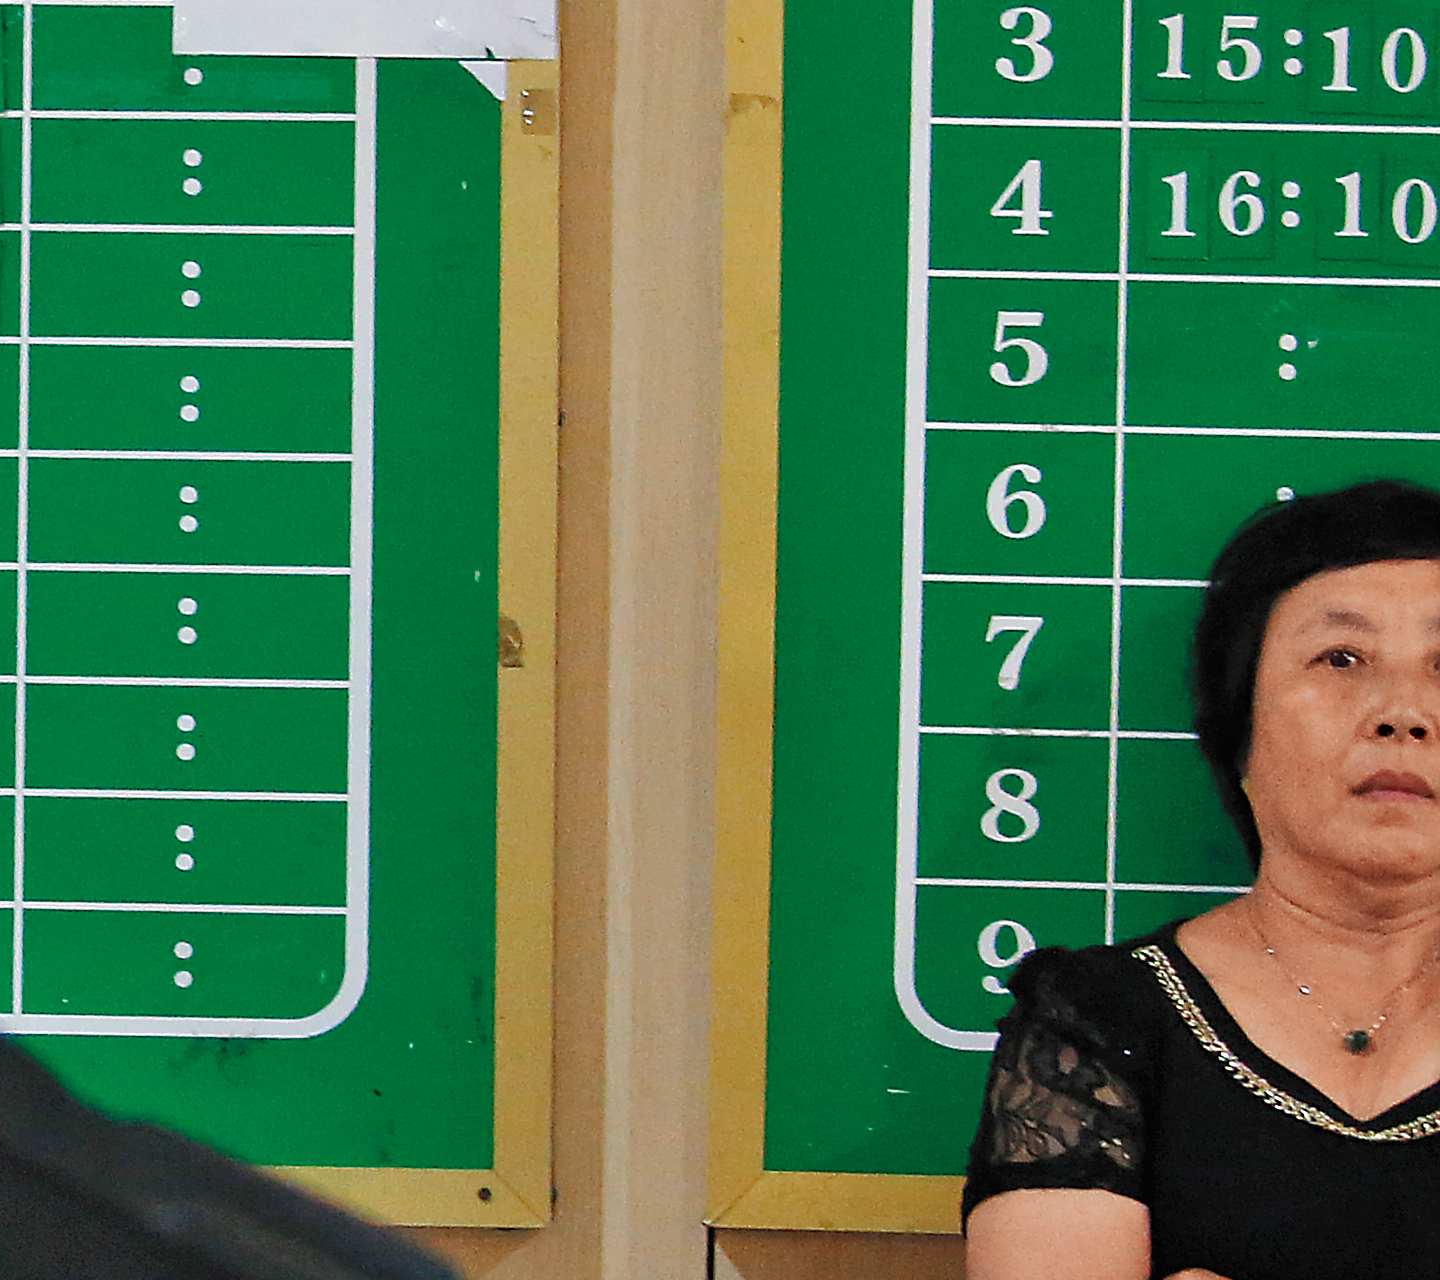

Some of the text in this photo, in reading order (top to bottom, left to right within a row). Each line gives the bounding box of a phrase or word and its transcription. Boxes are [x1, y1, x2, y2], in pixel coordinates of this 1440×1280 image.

[996, 7, 1426, 92] 3 15:10
[991, 160, 1437, 243] 4 16:10
[990, 312, 1048, 386] 5
[987, 464, 1046, 538] 6
[986, 616, 1043, 690] 7
[981, 769, 1040, 842] 8
